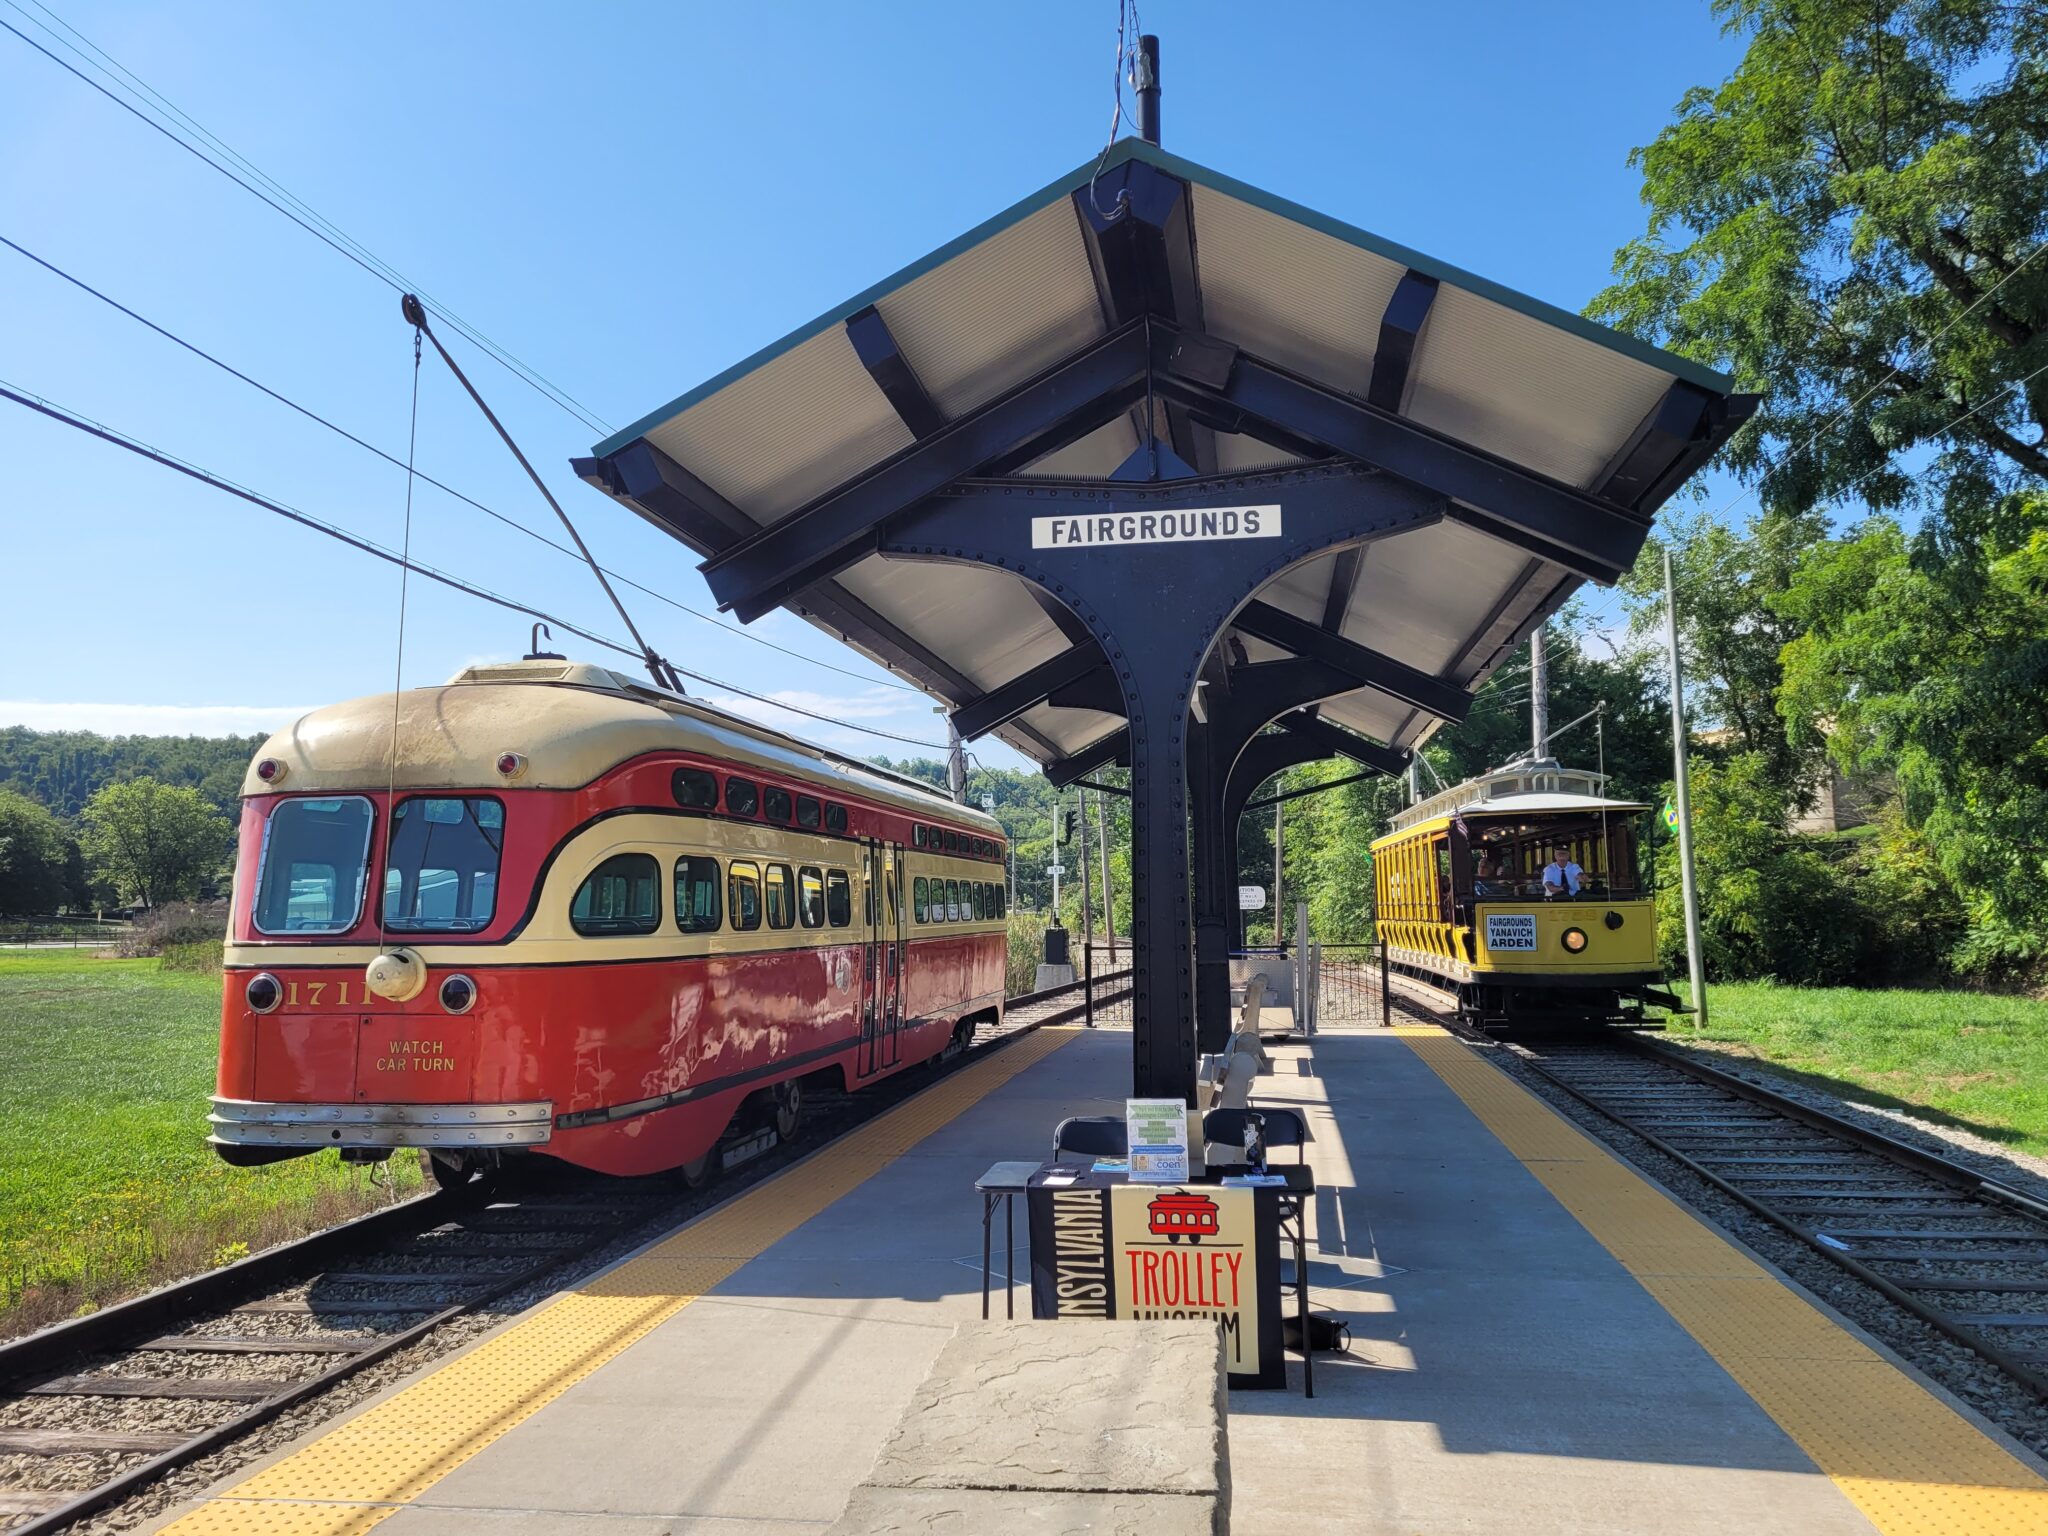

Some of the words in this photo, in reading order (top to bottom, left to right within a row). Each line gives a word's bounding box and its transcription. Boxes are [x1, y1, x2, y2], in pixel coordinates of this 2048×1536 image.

[1051, 509, 1261, 545] FAIRGROUNDS
[1489, 917, 1533, 927] FAIRGROUNDS
[1490, 927, 1533, 937] YANAVICH
[1490, 938, 1534, 948] ARDEN
[287, 981, 376, 1006] 1711
[389, 1040, 444, 1054] WATCH
[376, 1057, 407, 1071] CAR
[412, 1058, 455, 1071] TURN
[1156, 1160, 1181, 1169] coen
[1052, 1189, 1107, 1320] NSYLVANIA
[1125, 1250, 1243, 1308] TROLLEY
